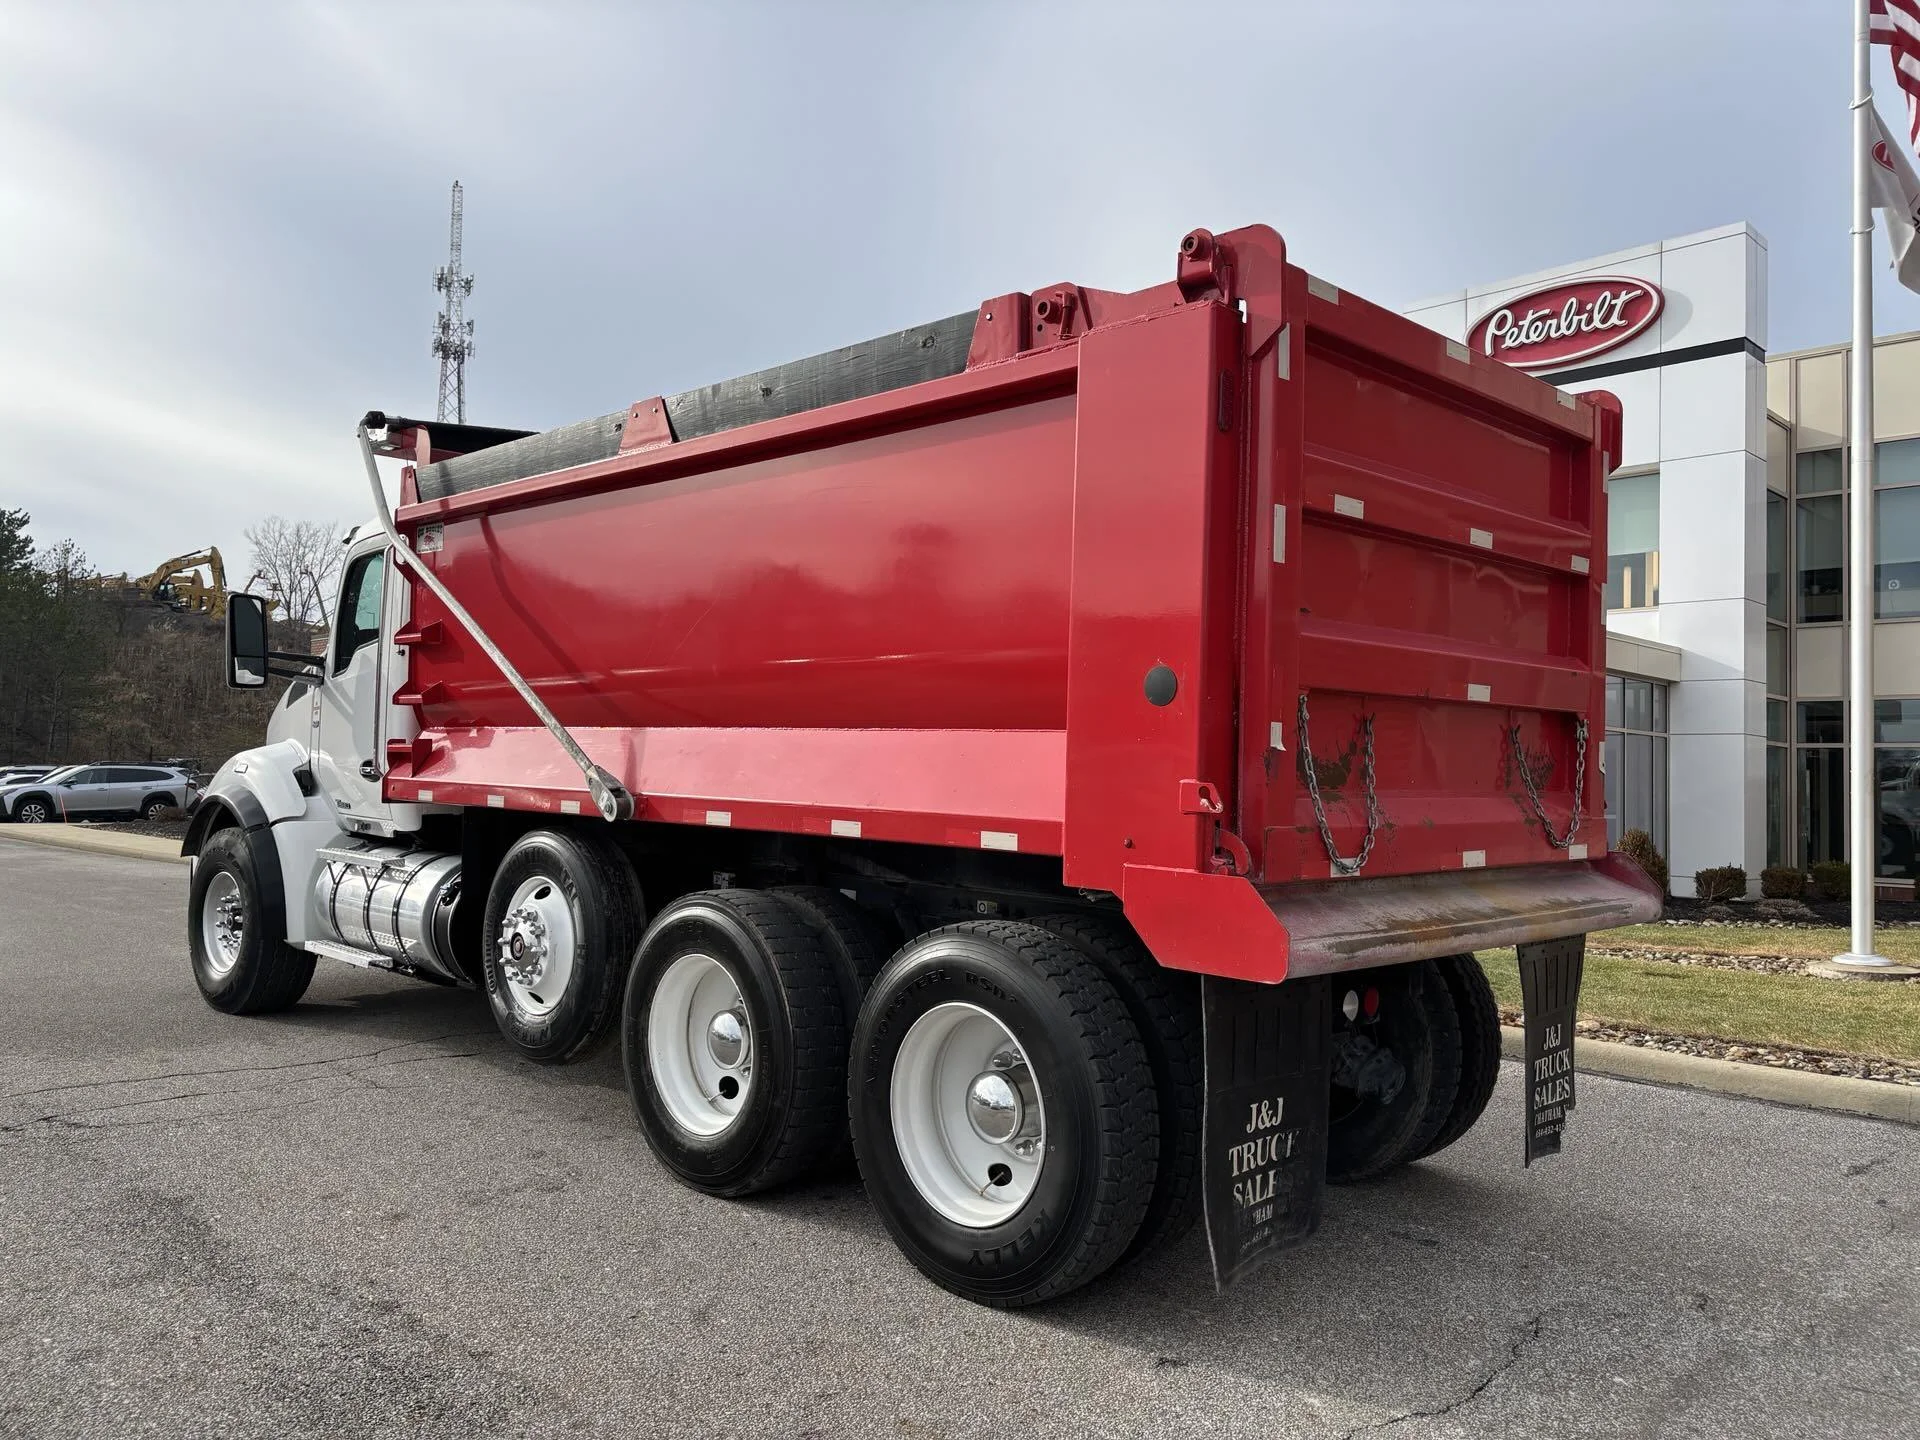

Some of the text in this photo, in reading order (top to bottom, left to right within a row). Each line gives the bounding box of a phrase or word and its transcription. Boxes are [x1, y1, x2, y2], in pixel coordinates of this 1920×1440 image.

[1484, 289, 1644, 357] Peterbilt
[1543, 1023, 1562, 1050] J&J
[1534, 1048, 1571, 1082] TRUCK
[1534, 1076, 1571, 1110] SALES
[1246, 1096, 1284, 1134] J&J
[1233, 1167, 1280, 1208] SALE
